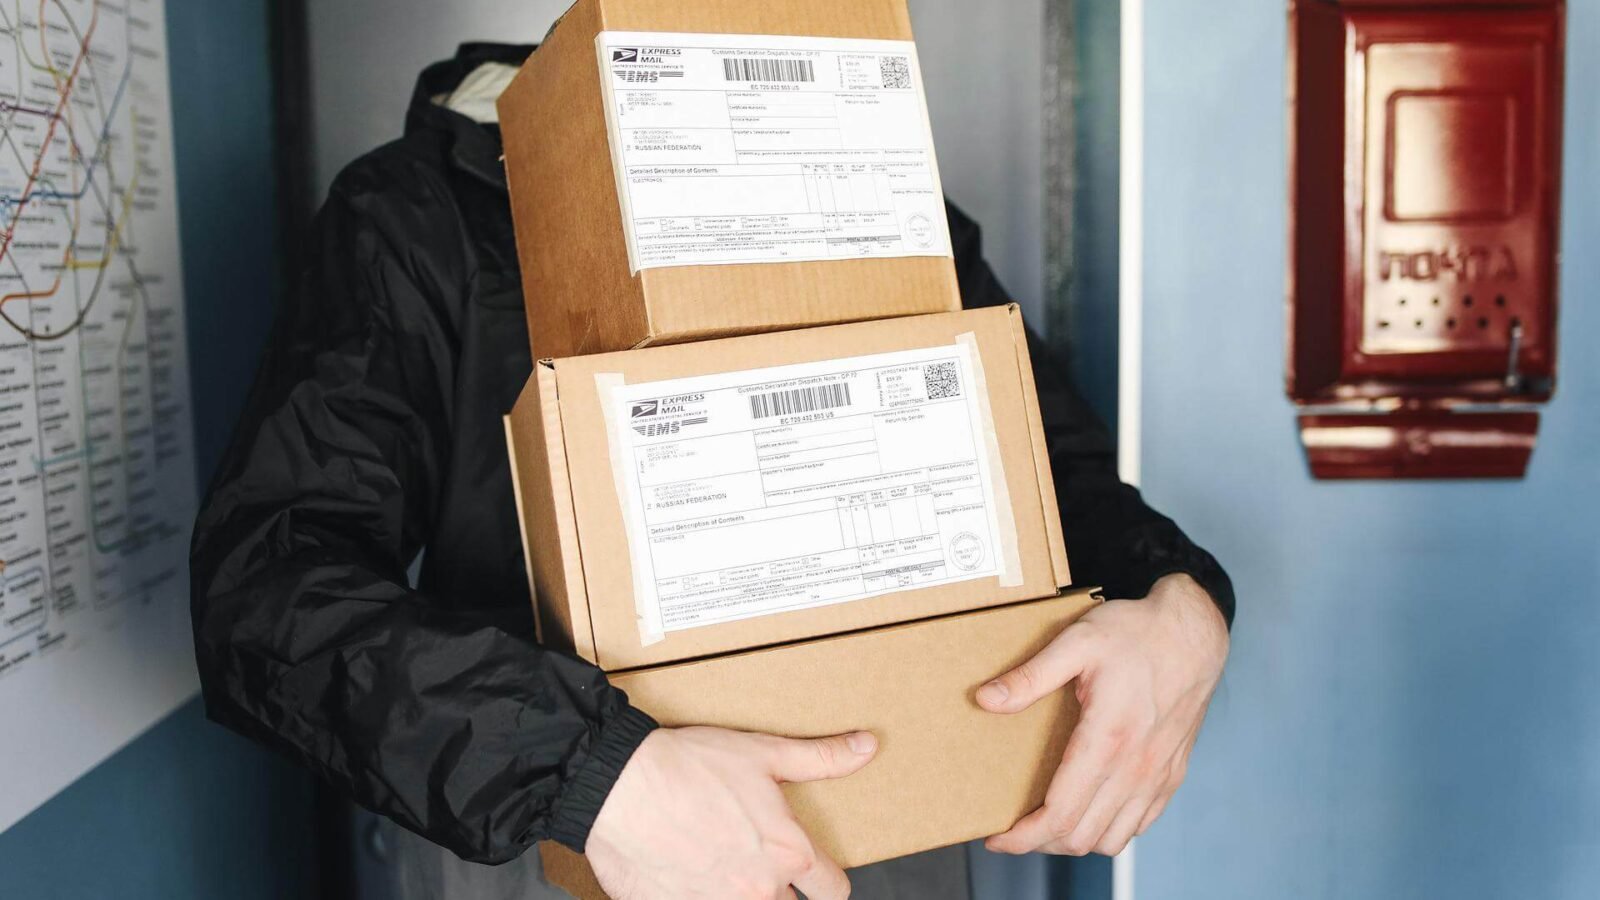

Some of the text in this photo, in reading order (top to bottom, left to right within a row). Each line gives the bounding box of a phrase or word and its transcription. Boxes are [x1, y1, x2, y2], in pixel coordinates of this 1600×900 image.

[627, 70, 658, 82] EMS
[765, 381, 797, 390] Declaration
[662, 393, 705, 405] EXPRESS
[661, 405, 685, 414] MAIL
[647, 421, 680, 437] EMS
[656, 493, 727, 508] RUSSIAN FEDERATION
[651, 526, 675, 534] Detailed
[676, 521, 709, 530] Description
[718, 515, 744, 524] Contents
